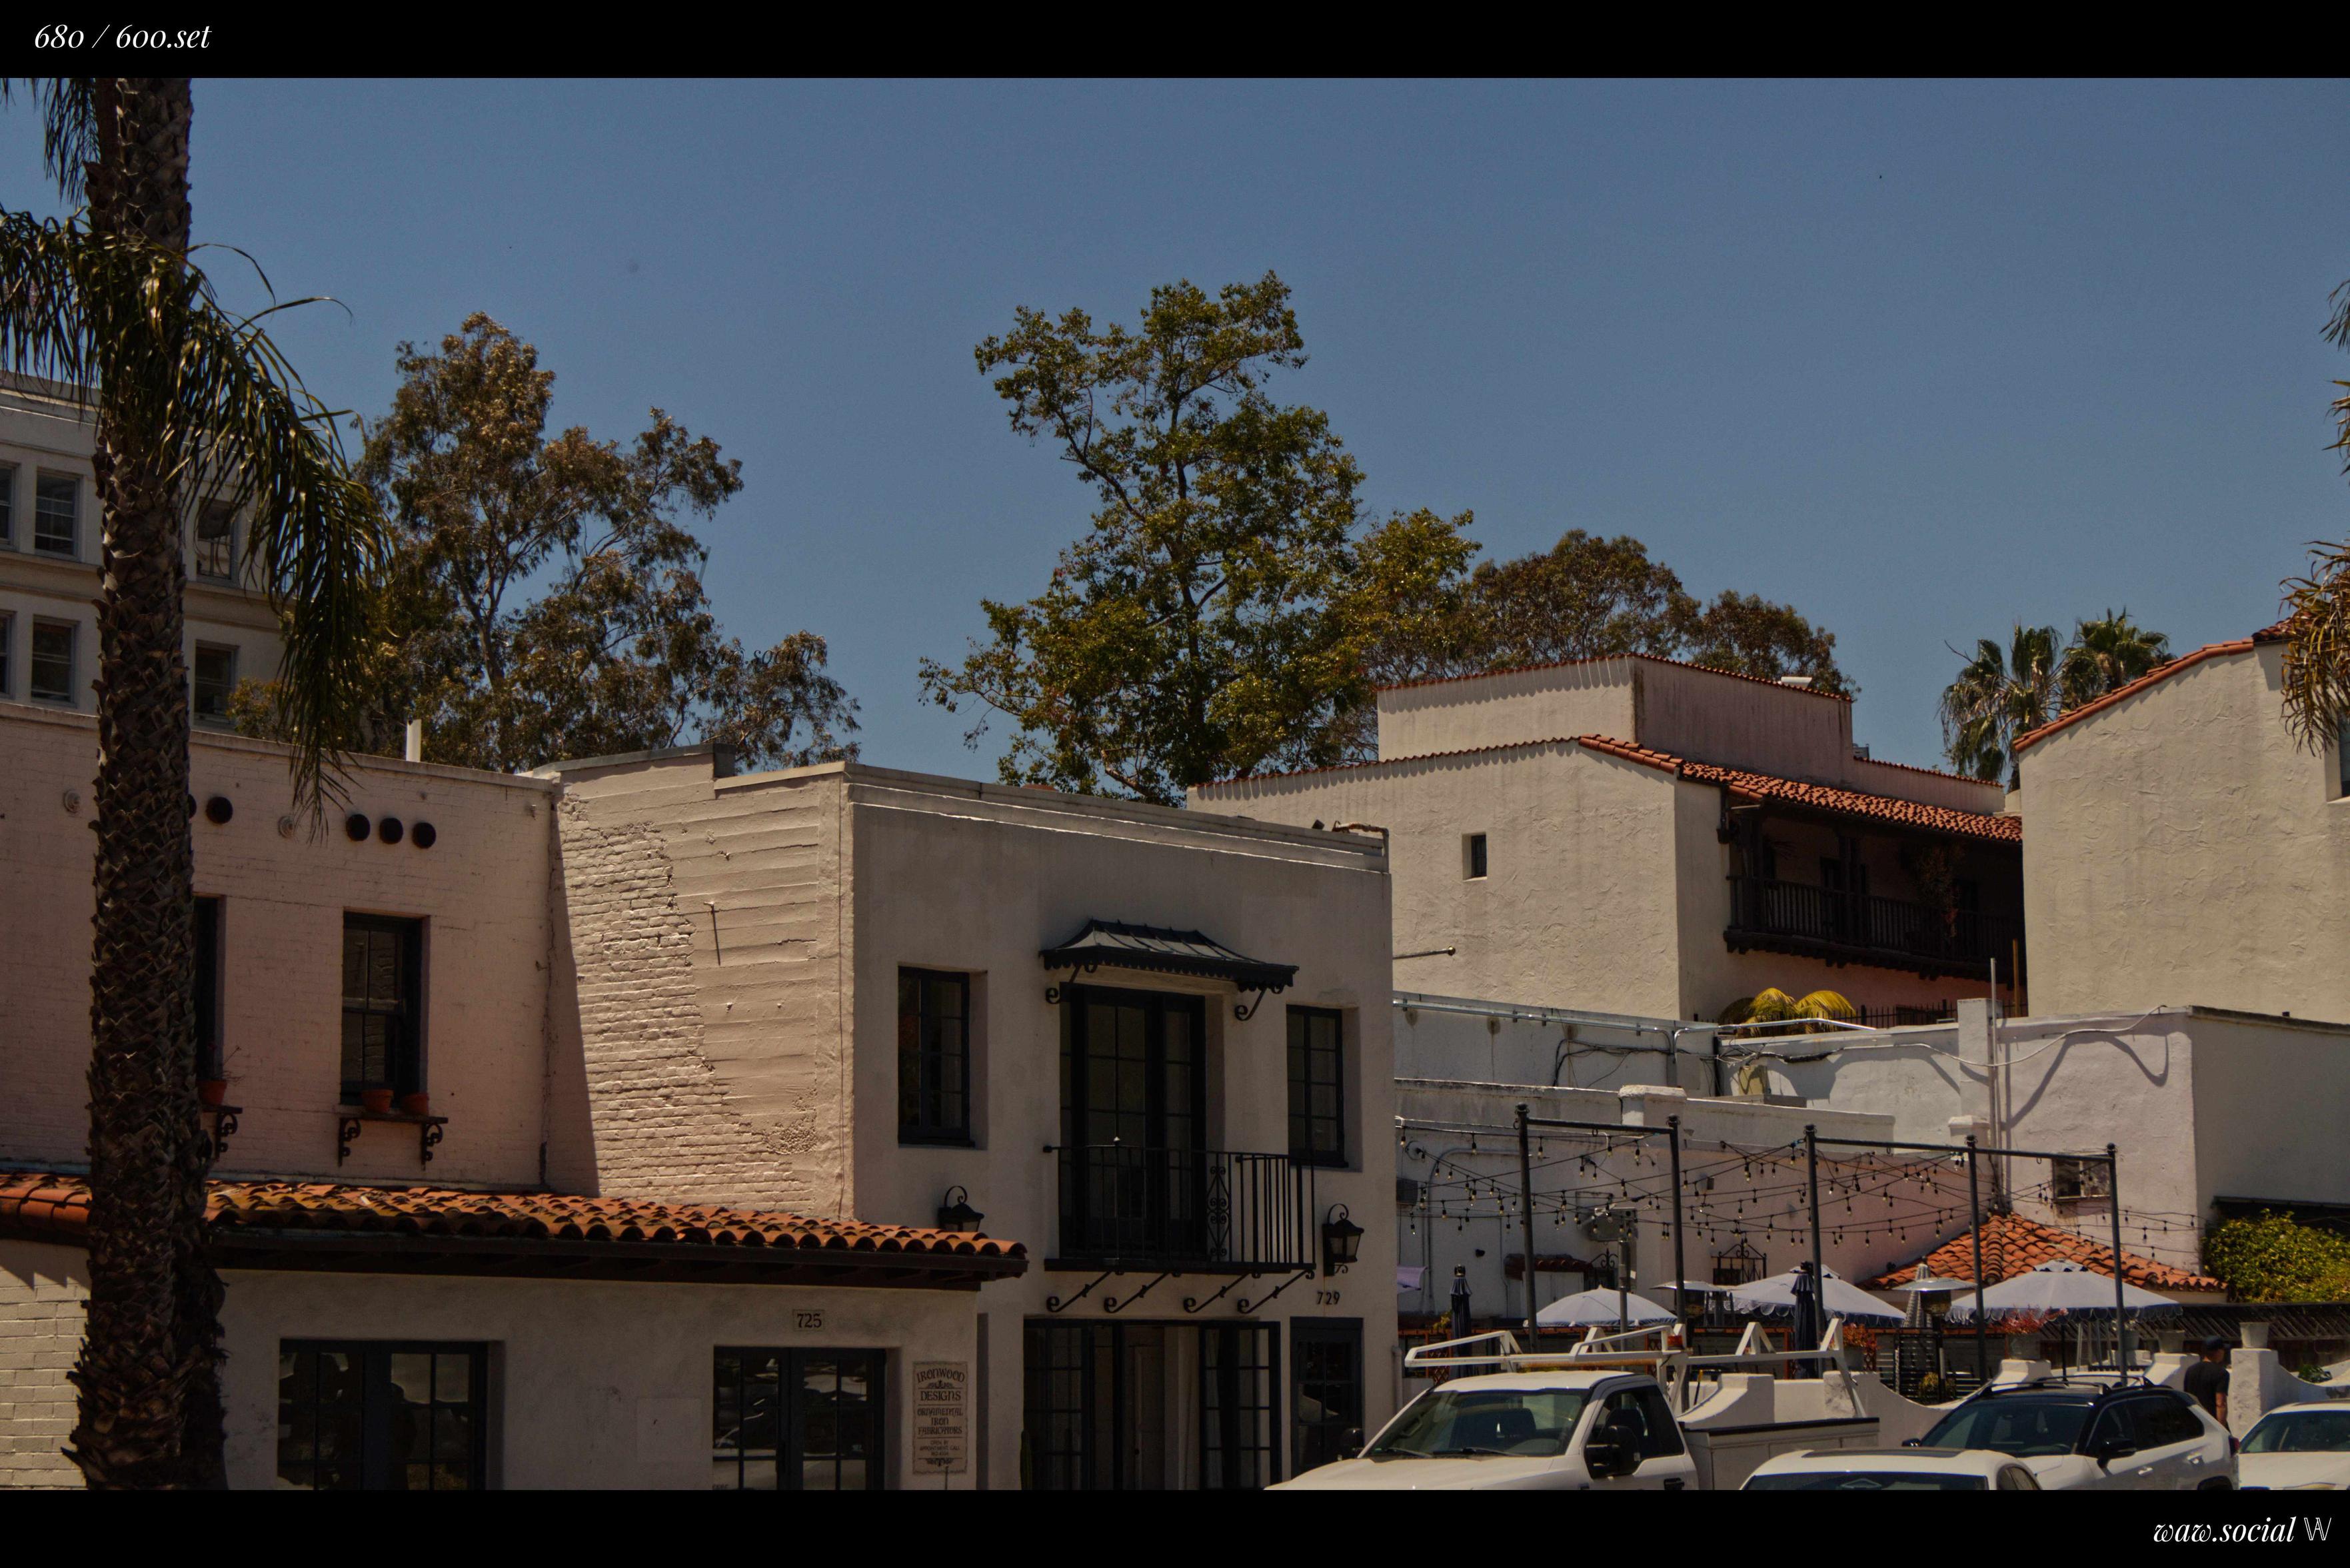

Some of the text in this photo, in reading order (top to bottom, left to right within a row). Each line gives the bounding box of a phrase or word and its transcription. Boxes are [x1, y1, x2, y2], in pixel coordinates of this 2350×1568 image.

[1316, 1291, 1340, 1305] 729
[797, 1313, 822, 1328] 725
[916, 1367, 965, 1383] IRONWOOD
[920, 1390, 961, 1401] DESIGNS
[917, 1407, 963, 1417] ORNAMENTAL
[931, 1417, 949, 1425] IRON
[918, 1426, 962, 1435] FABRICATORS
